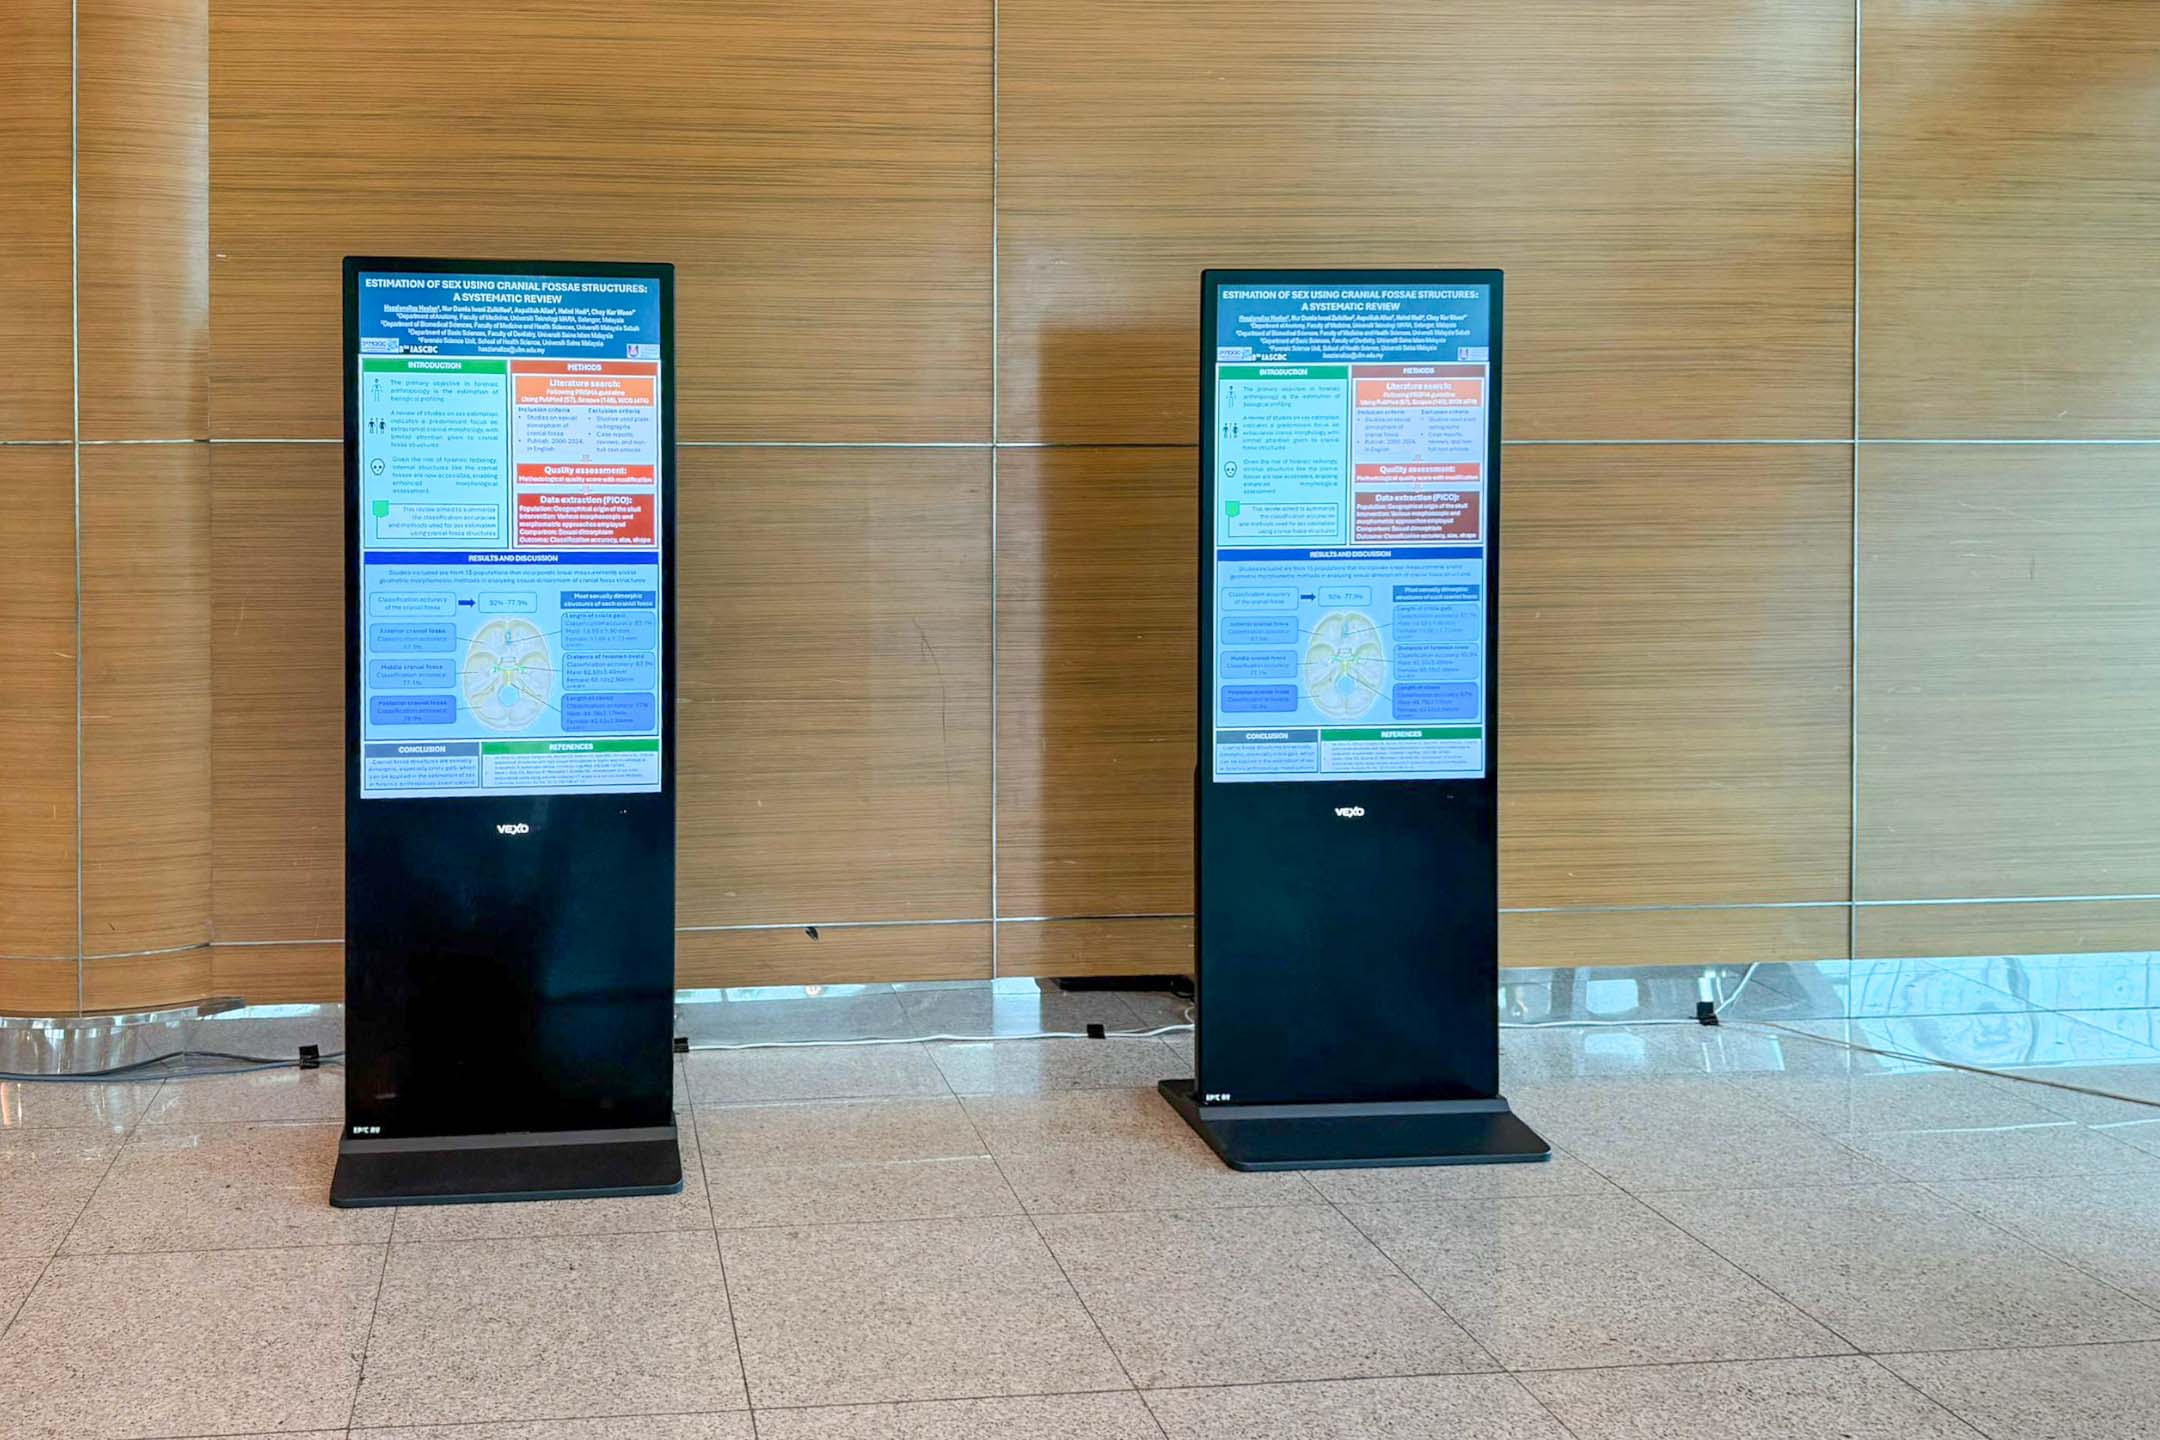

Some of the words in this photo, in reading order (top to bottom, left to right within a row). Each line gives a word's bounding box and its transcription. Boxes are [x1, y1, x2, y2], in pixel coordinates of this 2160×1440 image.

[365, 279, 426, 289] ESTIMATION
[426, 279, 440, 290] OF
[442, 280, 462, 290] SEX
[462, 280, 495, 291] USING
[496, 281, 540, 291] CRANIAL
[542, 282, 580, 292] FOSSAE
[581, 283, 648, 293] STRUCTURES:
[453, 293, 462, 302] A
[461, 293, 523, 303] SYSTEMATIC
[524, 294, 562, 304] REVIEW
[1222, 290, 1277, 299] ESTIMATION
[1278, 290, 1290, 299] OF
[1292, 290, 1310, 299] SEX
[1310, 290, 1340, 299] USING
[1341, 290, 1380, 299] CRANIAL
[1381, 290, 1417, 299] FOSSAE
[1418, 290, 1479, 299] STRUCTURES:
[1301, 302, 1308, 311] A
[1309, 302, 1364, 311] SYSTEMATIC
[1365, 302, 1400, 311] REVIEW
[408, 361, 461, 369] INTRODUCTION
[567, 363, 602, 372] METHODS
[544, 466, 574, 475] Quality
[540, 496, 560, 504] Data
[560, 496, 602, 504] extraction
[468, 554, 499, 562] RESULTS
[499, 554, 515, 562] AND
[515, 554, 559, 562] DISCUSSION
[398, 745, 446, 753] CONCLUSION
[549, 743, 594, 751] REFERENCES
[1334, 805, 1365, 818] VEXO
[496, 822, 530, 835] VEXO
